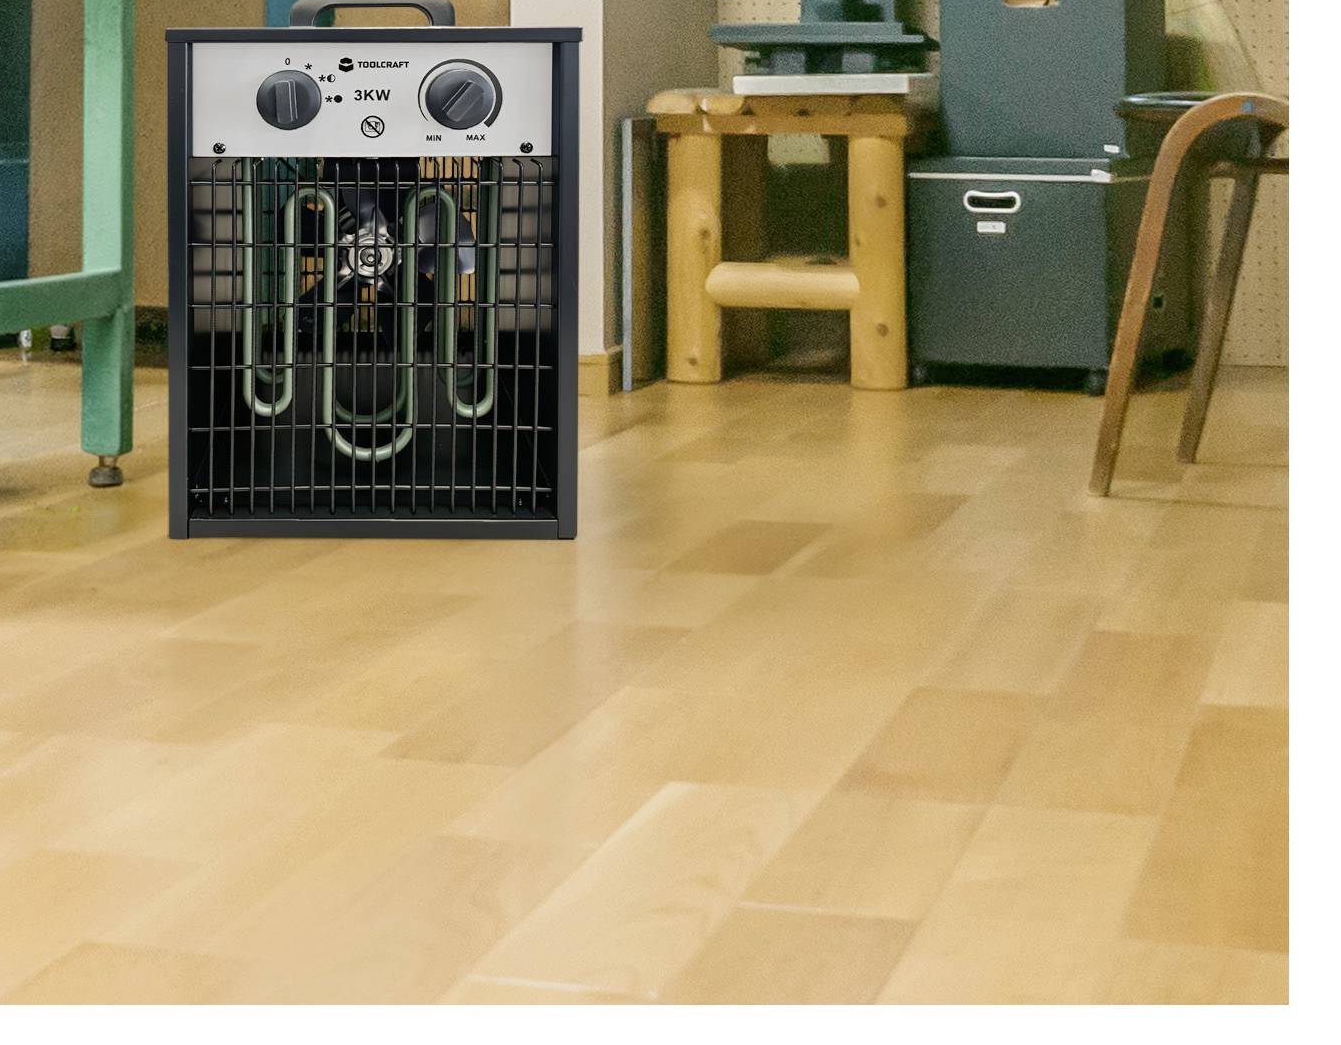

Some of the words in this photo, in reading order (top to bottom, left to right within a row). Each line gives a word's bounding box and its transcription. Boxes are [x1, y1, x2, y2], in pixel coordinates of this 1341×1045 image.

[357, 60, 410, 69] TOOLCRAFT
[353, 89, 391, 101] 3KW
[425, 134, 442, 142] MIN
[465, 133, 486, 141] MAX
